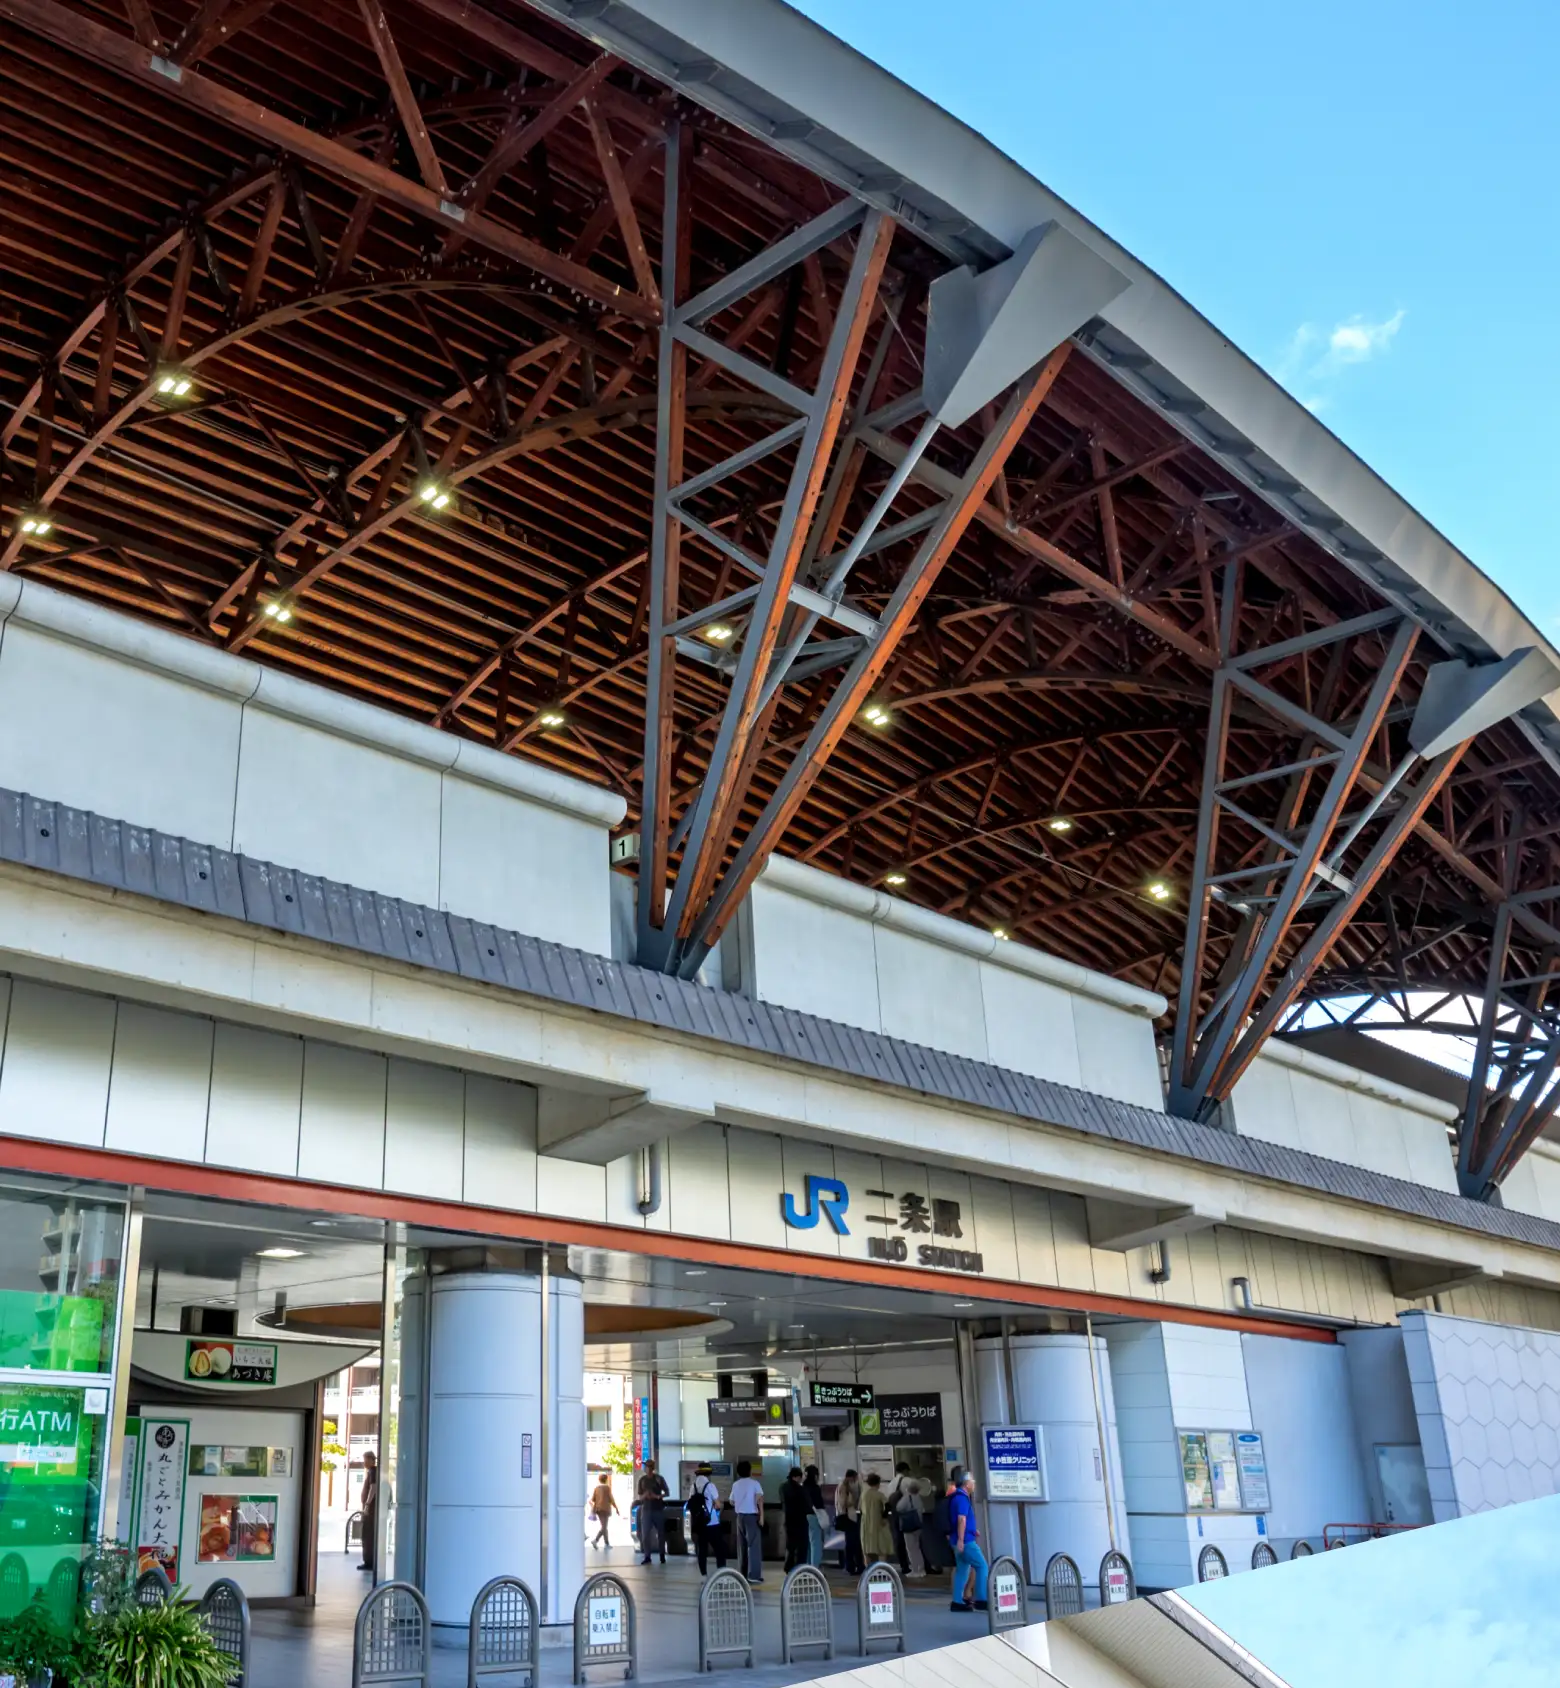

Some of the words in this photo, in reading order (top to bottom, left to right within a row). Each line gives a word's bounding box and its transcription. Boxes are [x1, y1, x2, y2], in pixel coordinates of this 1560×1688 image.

[618, 839, 626, 857] 1
[780, 1173, 851, 1236] JR
[865, 1189, 964, 1239] 二条駅
[820, 1386, 853, 1397] きっぷうりば
[882, 1405, 937, 1419] きっぷうりば
[883, 1419, 908, 1428] Tickets
